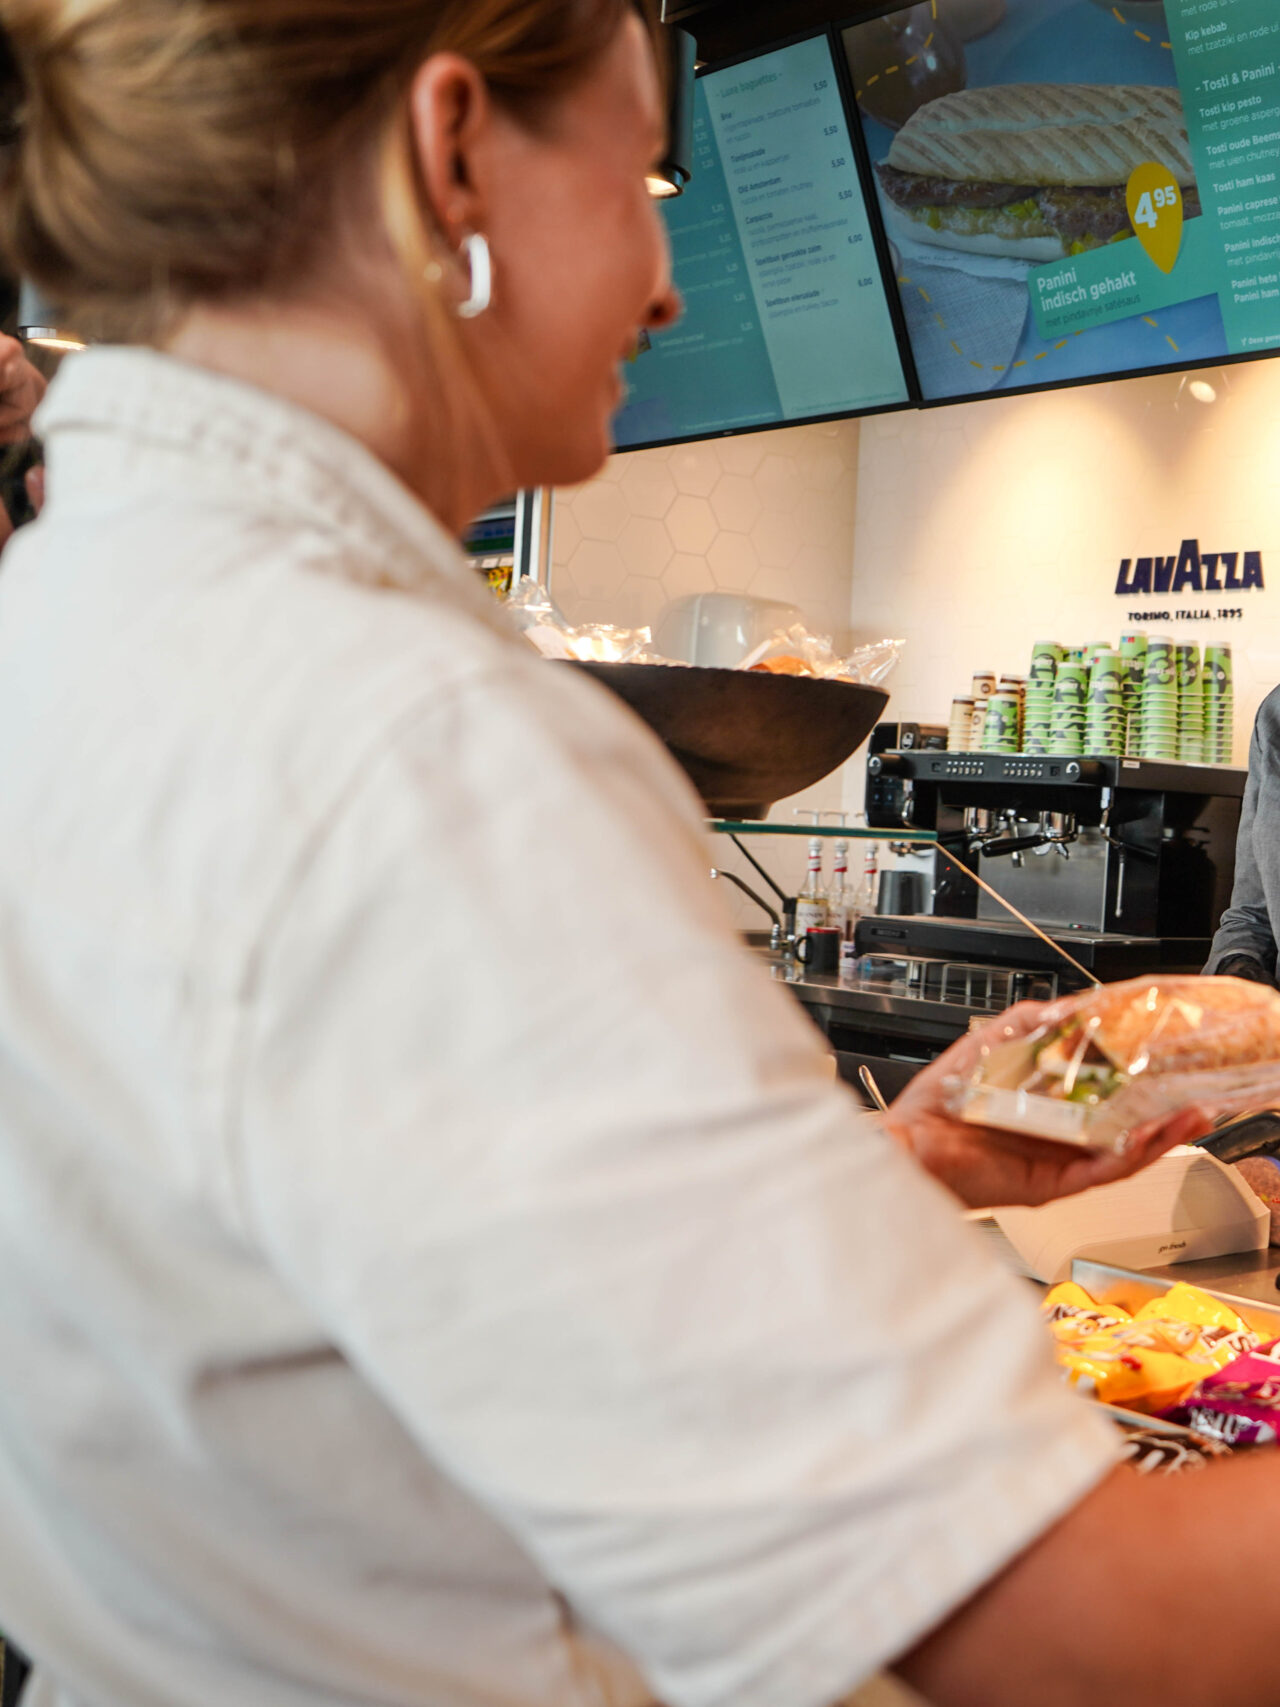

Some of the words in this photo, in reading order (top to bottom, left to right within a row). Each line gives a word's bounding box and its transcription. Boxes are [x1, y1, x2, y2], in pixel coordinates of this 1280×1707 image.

[1185, 30, 1199, 40] Kip
[1200, 22, 1227, 36] kebab
[1188, 44, 1204, 56] met
[1237, 32, 1247, 42] en
[1250, 25, 1270, 40] rode
[1202, 74, 1229, 92] Tosti
[1232, 72, 1240, 85] &
[1241, 62, 1275, 82] Panini
[1199, 104, 1220, 118] Tosti
[1222, 102, 1236, 113] kip
[1237, 96, 1262, 110] pesto
[1202, 121, 1218, 132] met
[1220, 114, 1250, 130] groene
[1206, 142, 1228, 156] Tosti
[1228, 138, 1251, 150] oude
[1246, 147, 1280, 162] chutney
[1212, 181, 1234, 193] Tosti
[1236, 177, 1255, 188] ham
[1256, 172, 1276, 185] kaas
[1217, 202, 1244, 216] Panini
[1244, 196, 1278, 210] caprese
[1224, 240, 1250, 253] Panini
[1036, 267, 1078, 294] Panini
[1232, 276, 1257, 289] Panini
[1040, 286, 1088, 312] indisch
[1090, 270, 1137, 301] gehakt
[1234, 290, 1260, 304] Panini
[1261, 288, 1280, 299] ham
[1114, 539, 1265, 594] LAVAZZA
[1218, 608, 1243, 619] 1895
